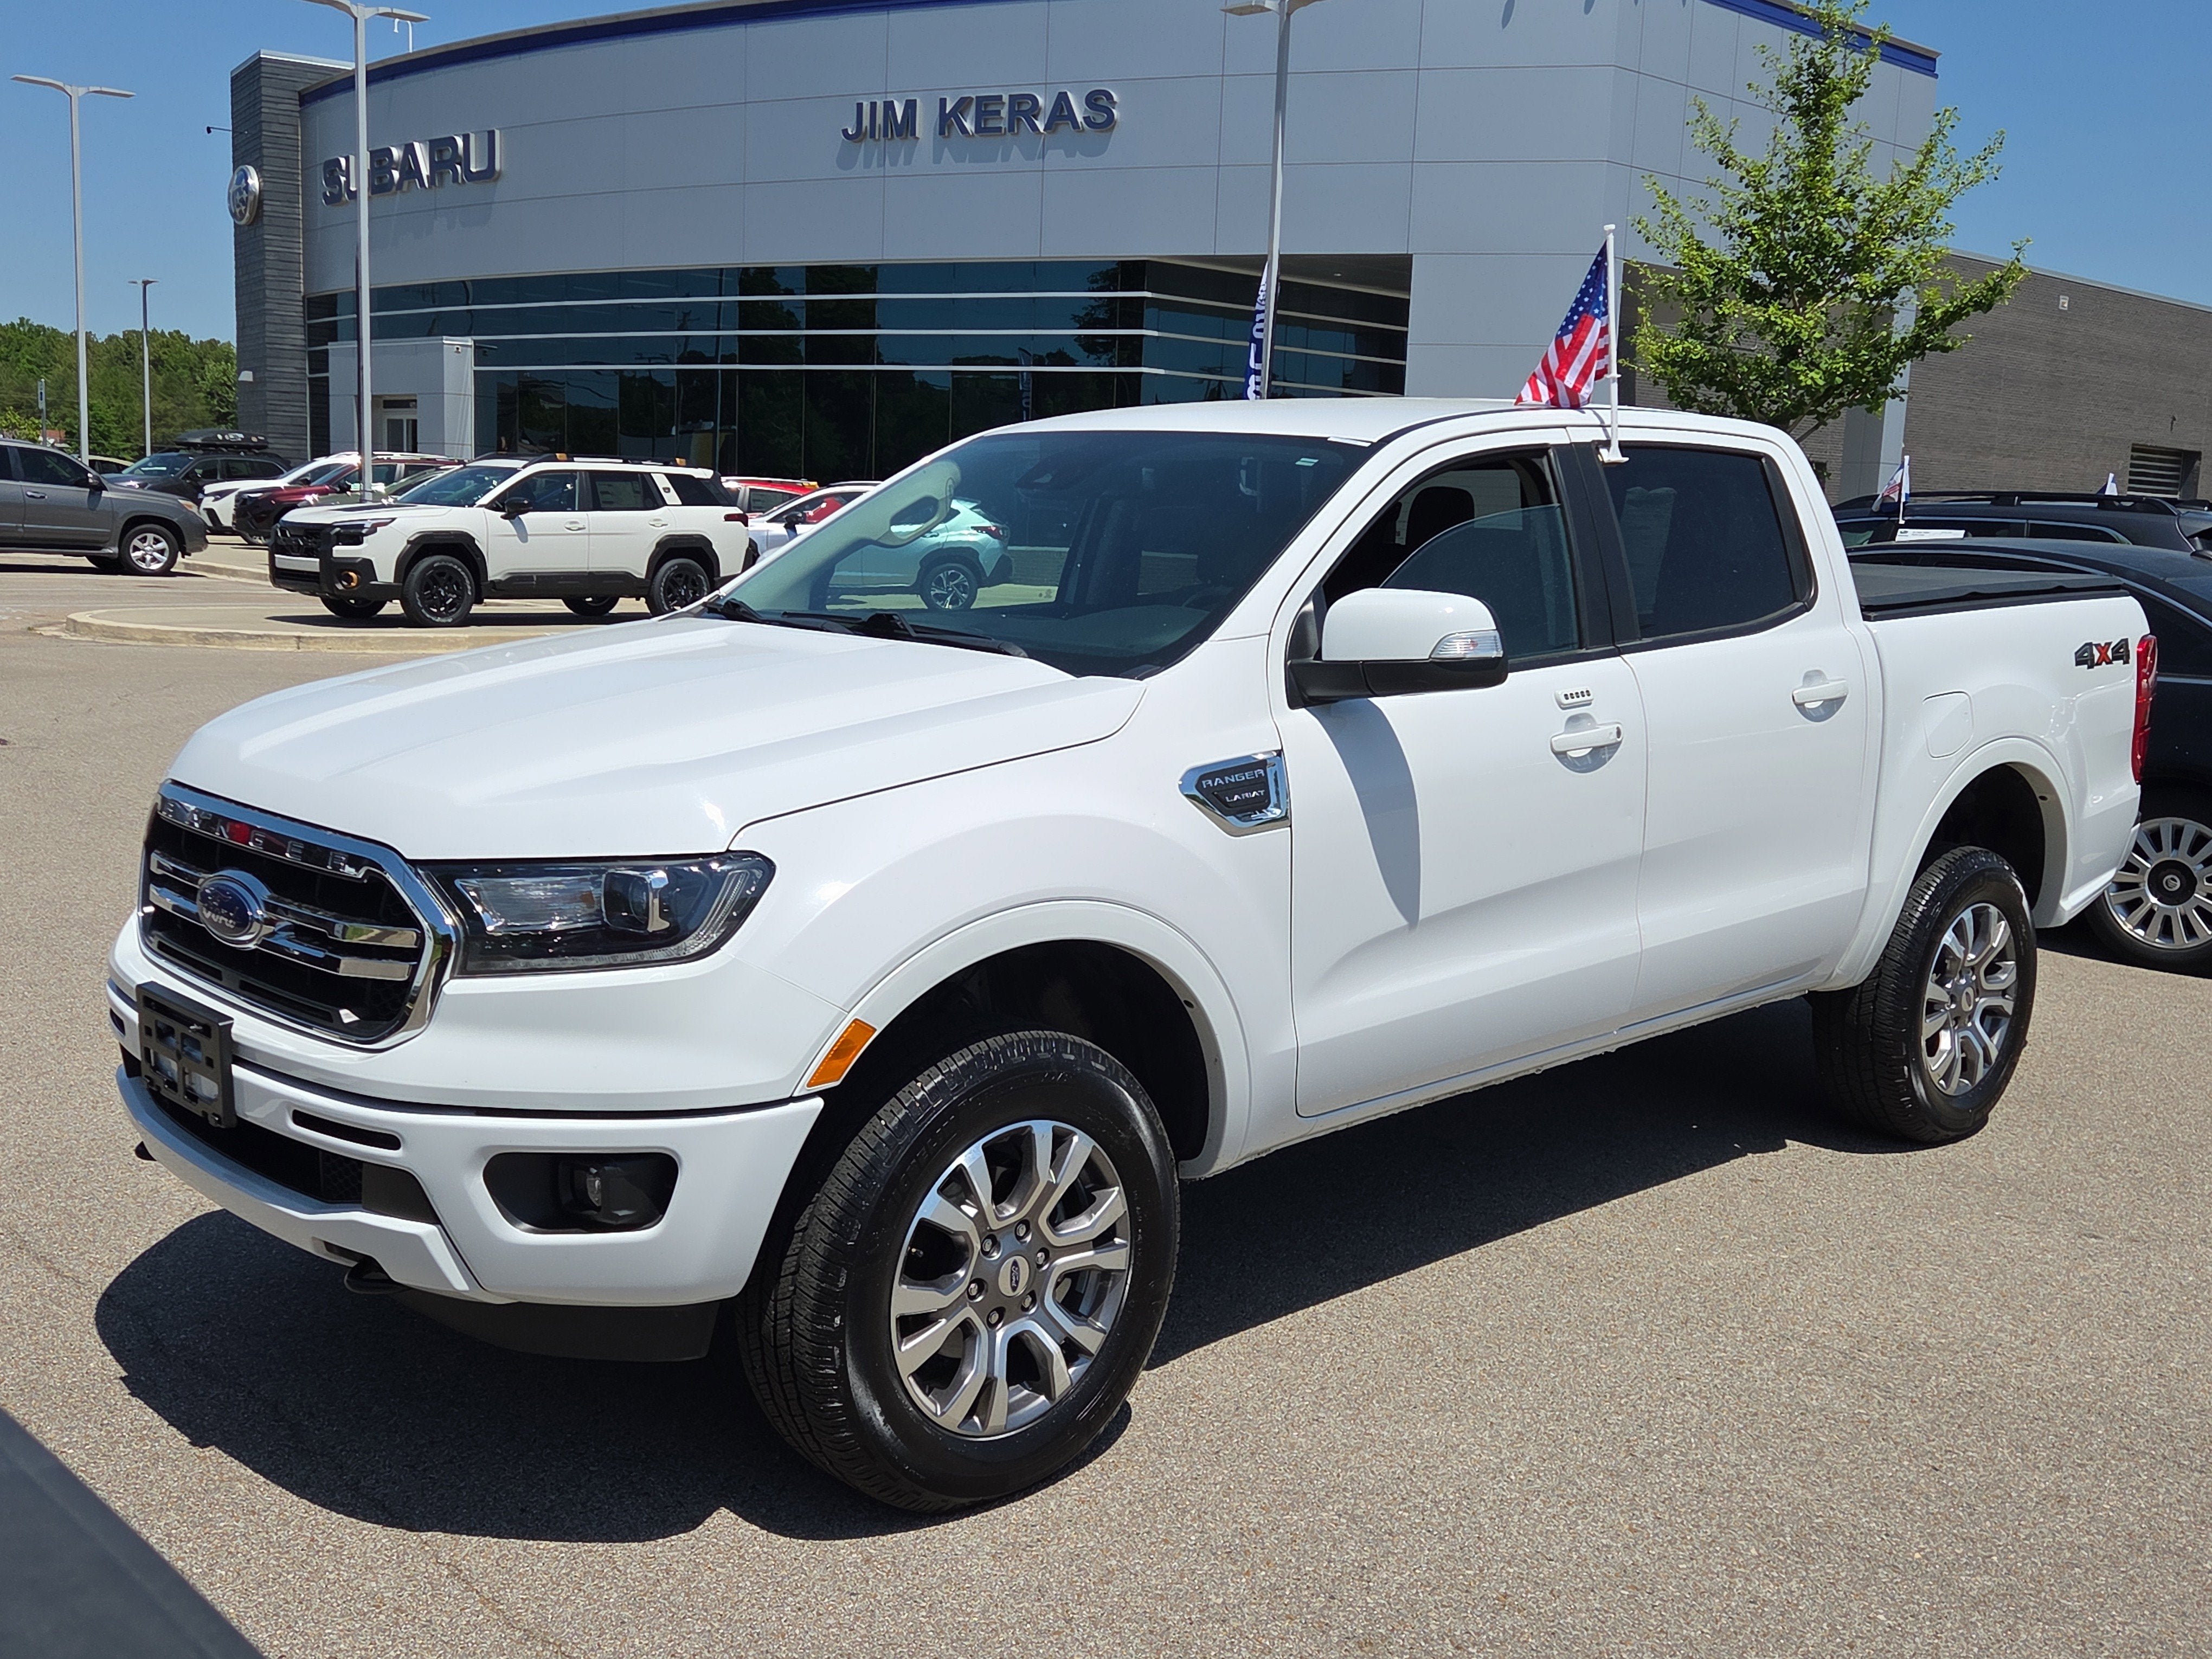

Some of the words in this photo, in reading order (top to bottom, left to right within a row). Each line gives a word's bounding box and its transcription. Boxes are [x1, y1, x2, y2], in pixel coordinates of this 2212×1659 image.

[841, 98, 918, 142] JIM
[938, 89, 1117, 136] KERAS
[1201, 768, 1265, 789] RANGER
[1225, 789, 1265, 802] LARIAT
